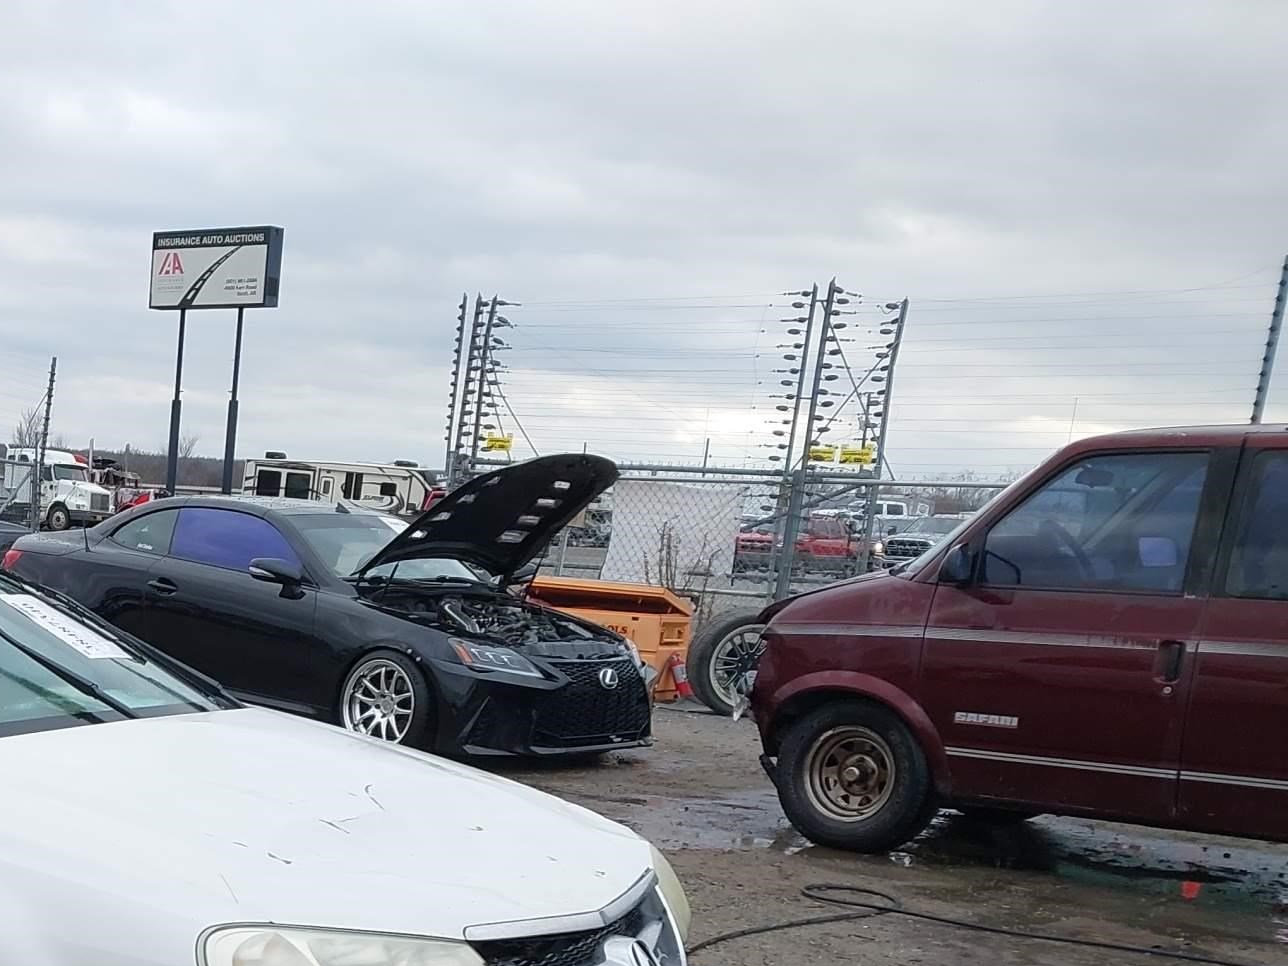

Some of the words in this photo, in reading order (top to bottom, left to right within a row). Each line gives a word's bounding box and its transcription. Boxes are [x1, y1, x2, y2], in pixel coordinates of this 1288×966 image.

[158, 236, 201, 247] INSURANCE
[202, 235, 224, 244] AUTO
[224, 233, 265, 243] AUCTIONS
[954, 711, 1019, 729] SAFARI
